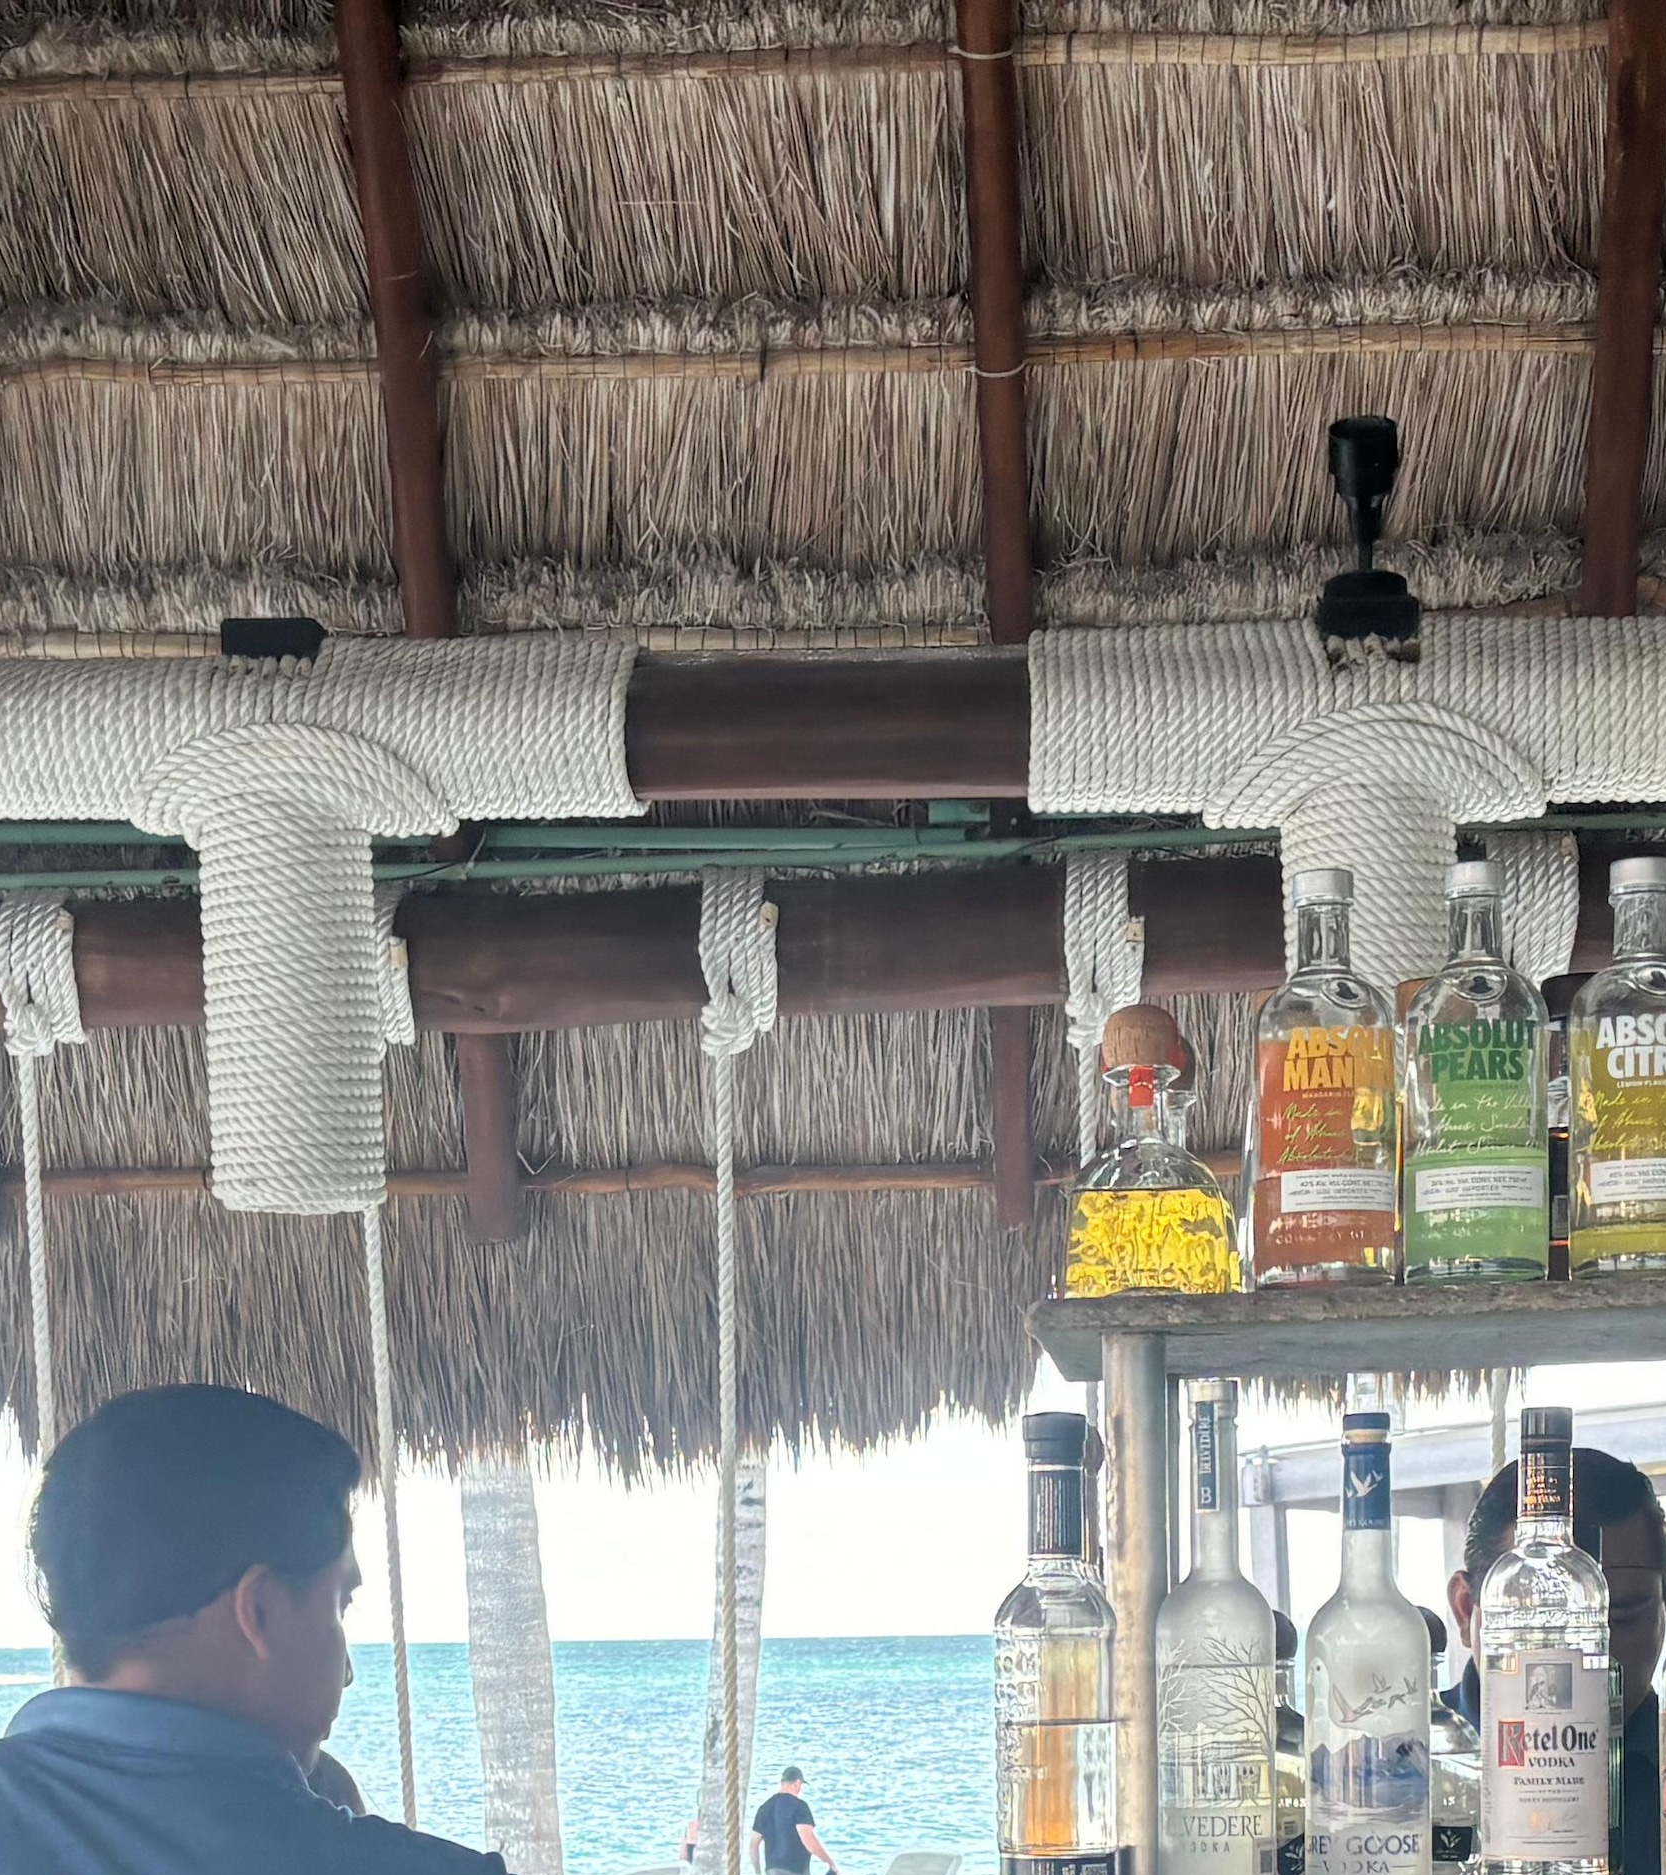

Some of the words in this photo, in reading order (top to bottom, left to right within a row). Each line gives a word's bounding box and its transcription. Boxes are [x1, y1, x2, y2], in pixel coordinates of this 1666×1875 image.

[1419, 1019, 1534, 1054] ABSOLUT
[1434, 1051, 1524, 1081] PEARS
[1201, 1485, 1212, 1504] B
[1498, 1721, 1558, 1767] Ketel
[1561, 1724, 1597, 1751] One
[1528, 1757, 1575, 1768] VODKA
[1514, 1777, 1552, 1786] FAMILY
[1555, 1777, 1585, 1785] MADE
[1183, 1815, 1262, 1840] VEDERE
[1190, 1841, 1230, 1853] ODKA
[1346, 1831, 1418, 1855] GOOSE
